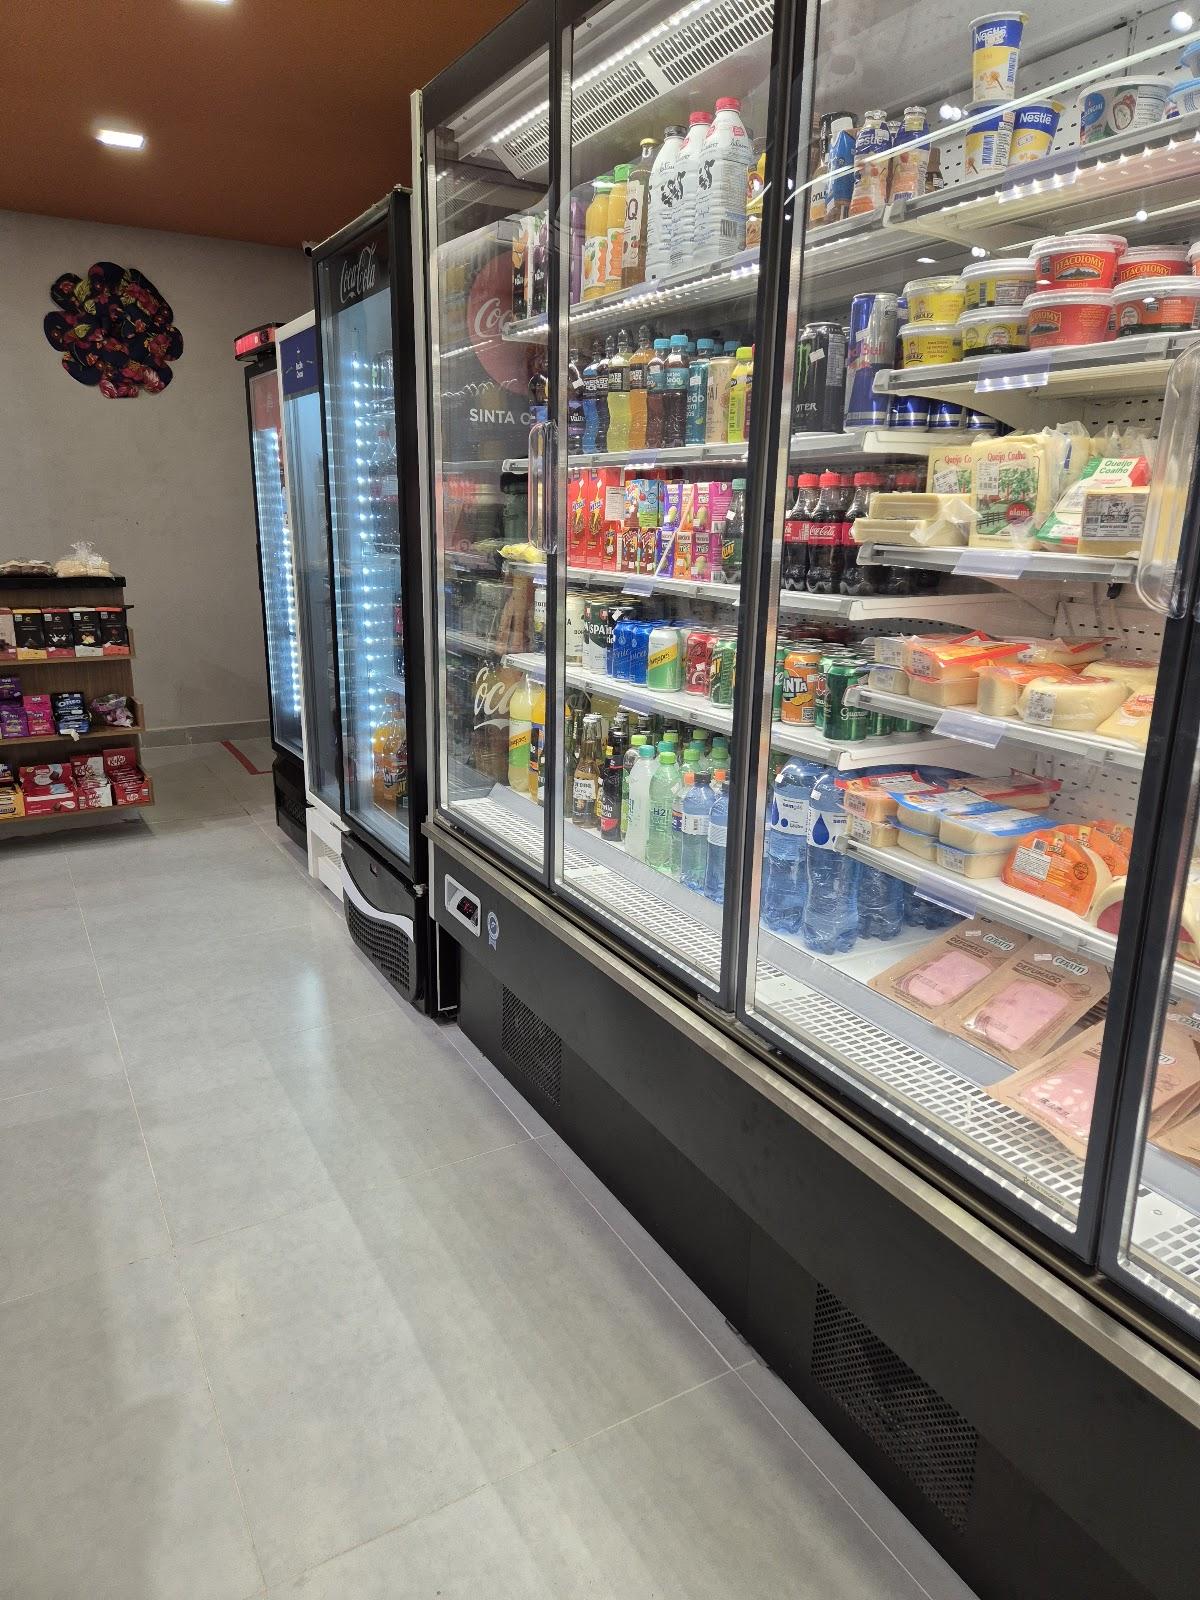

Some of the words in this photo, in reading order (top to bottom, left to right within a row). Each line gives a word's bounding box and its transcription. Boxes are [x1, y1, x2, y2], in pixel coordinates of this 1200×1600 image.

[1019, 111, 1053, 125] Nestlé
[1055, 253, 1105, 271] ITACOLOMY
[340, 242, 377, 304] Coca-Cola
[1121, 263, 1170, 280] ITACOLOMY
[469, 408, 516, 425] SINTA
[1104, 460, 1133, 468] Queijo
[809, 525, 837, 537] Coca-Cola
[58, 699, 81, 707] OREO
[949, 936, 989, 957] DEFUMADO
[1015, 962, 1062, 984] DEFUMADO
[1054, 957, 1089, 976] CERATTI
